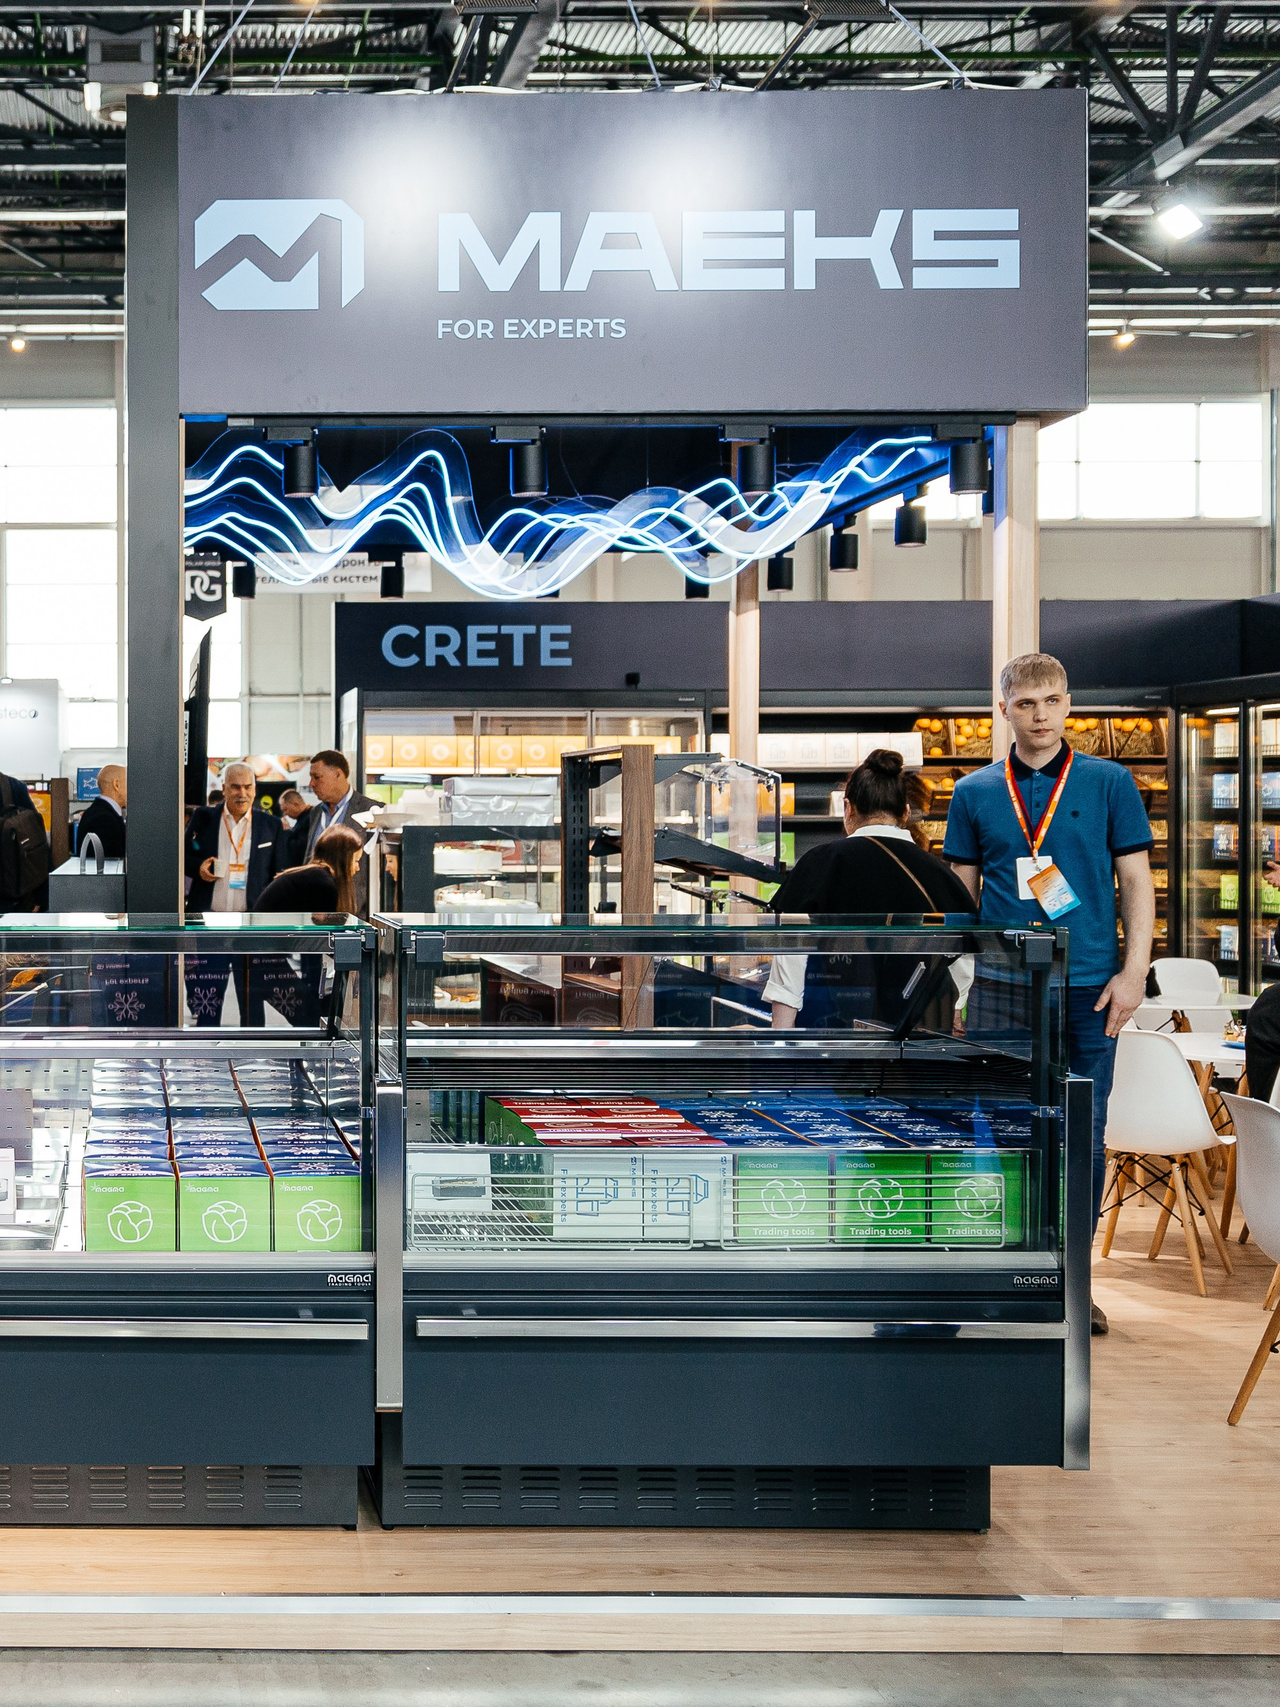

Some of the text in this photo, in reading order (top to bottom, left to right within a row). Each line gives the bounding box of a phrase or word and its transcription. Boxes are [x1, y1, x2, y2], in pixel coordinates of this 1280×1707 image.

[437, 209, 1020, 292] MAEKS
[437, 318, 627, 339] FOR EXPERTS
[381, 624, 572, 667] CRETE
[753, 1227, 815, 1237] Trading tools
[850, 1227, 912, 1237] Trading tools
[946, 1227, 1009, 1237] Trading toos
